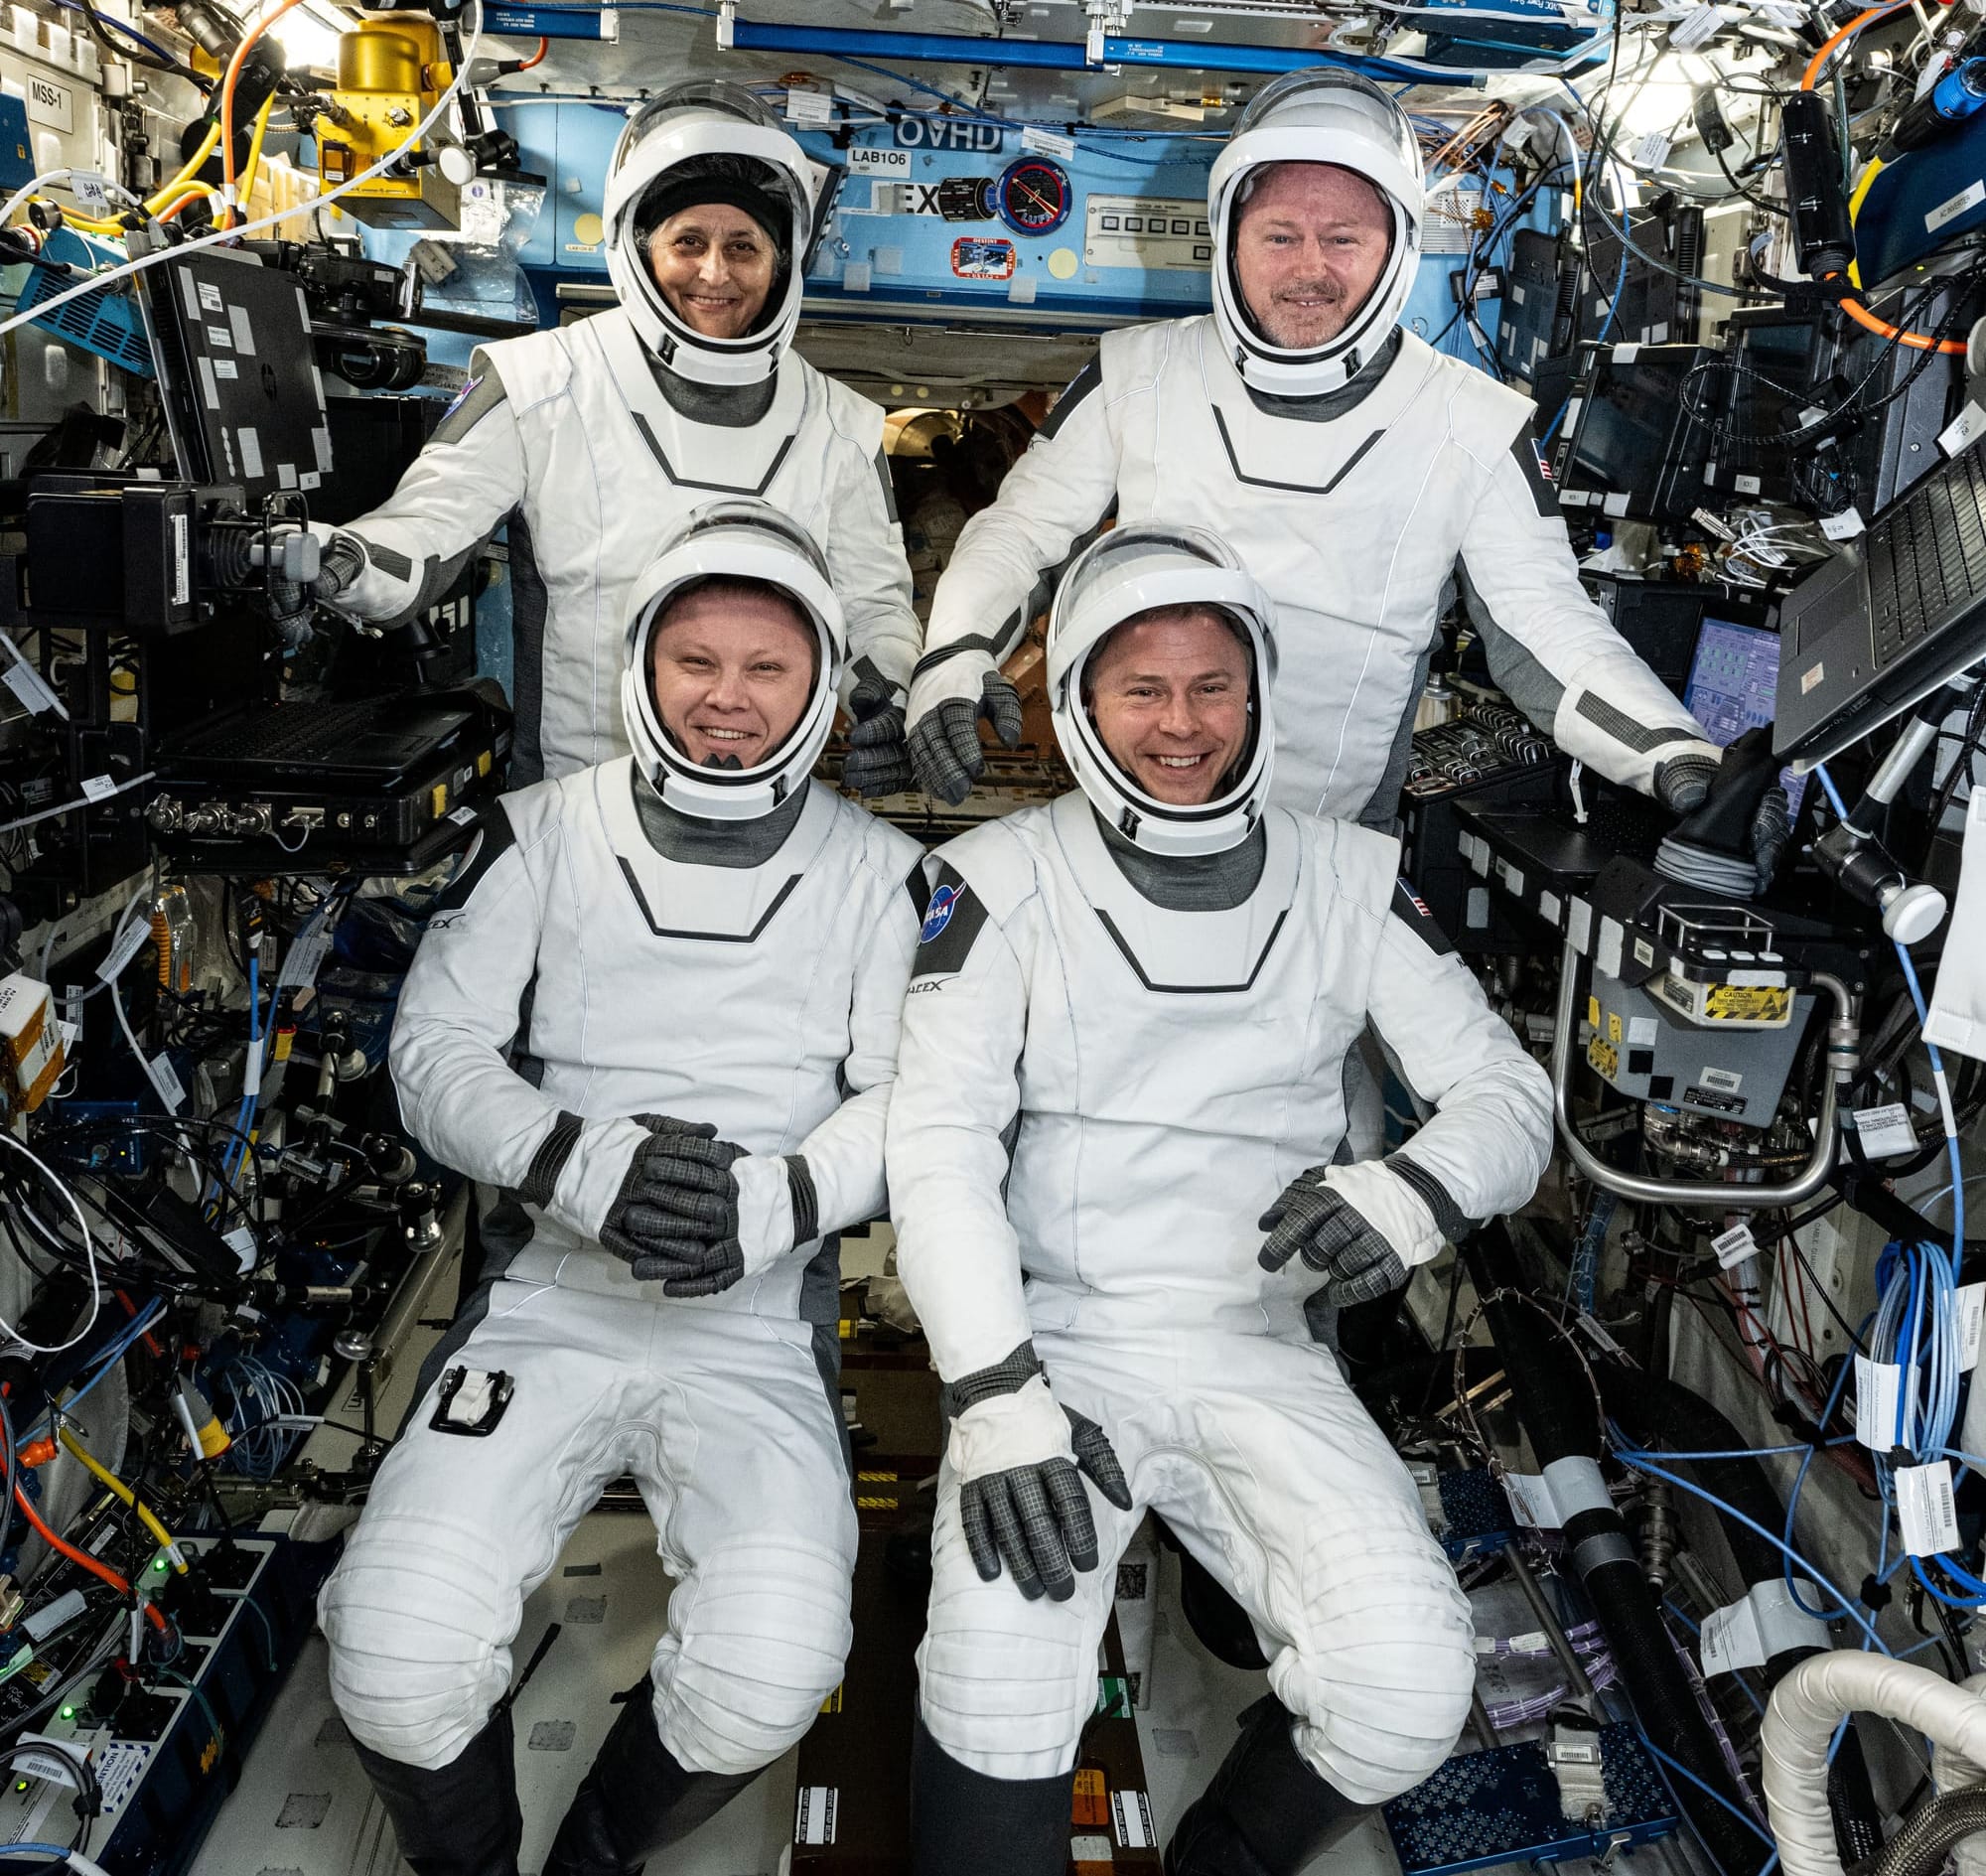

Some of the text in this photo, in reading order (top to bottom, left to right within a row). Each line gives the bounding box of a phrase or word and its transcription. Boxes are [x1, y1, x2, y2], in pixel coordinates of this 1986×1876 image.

[32, 80, 63, 109] MSS-1
[897, 118, 1000, 150] OVHD
[6, 1693, 31, 1711] INPUT
[9, 1684, 24, 1698] VDC
